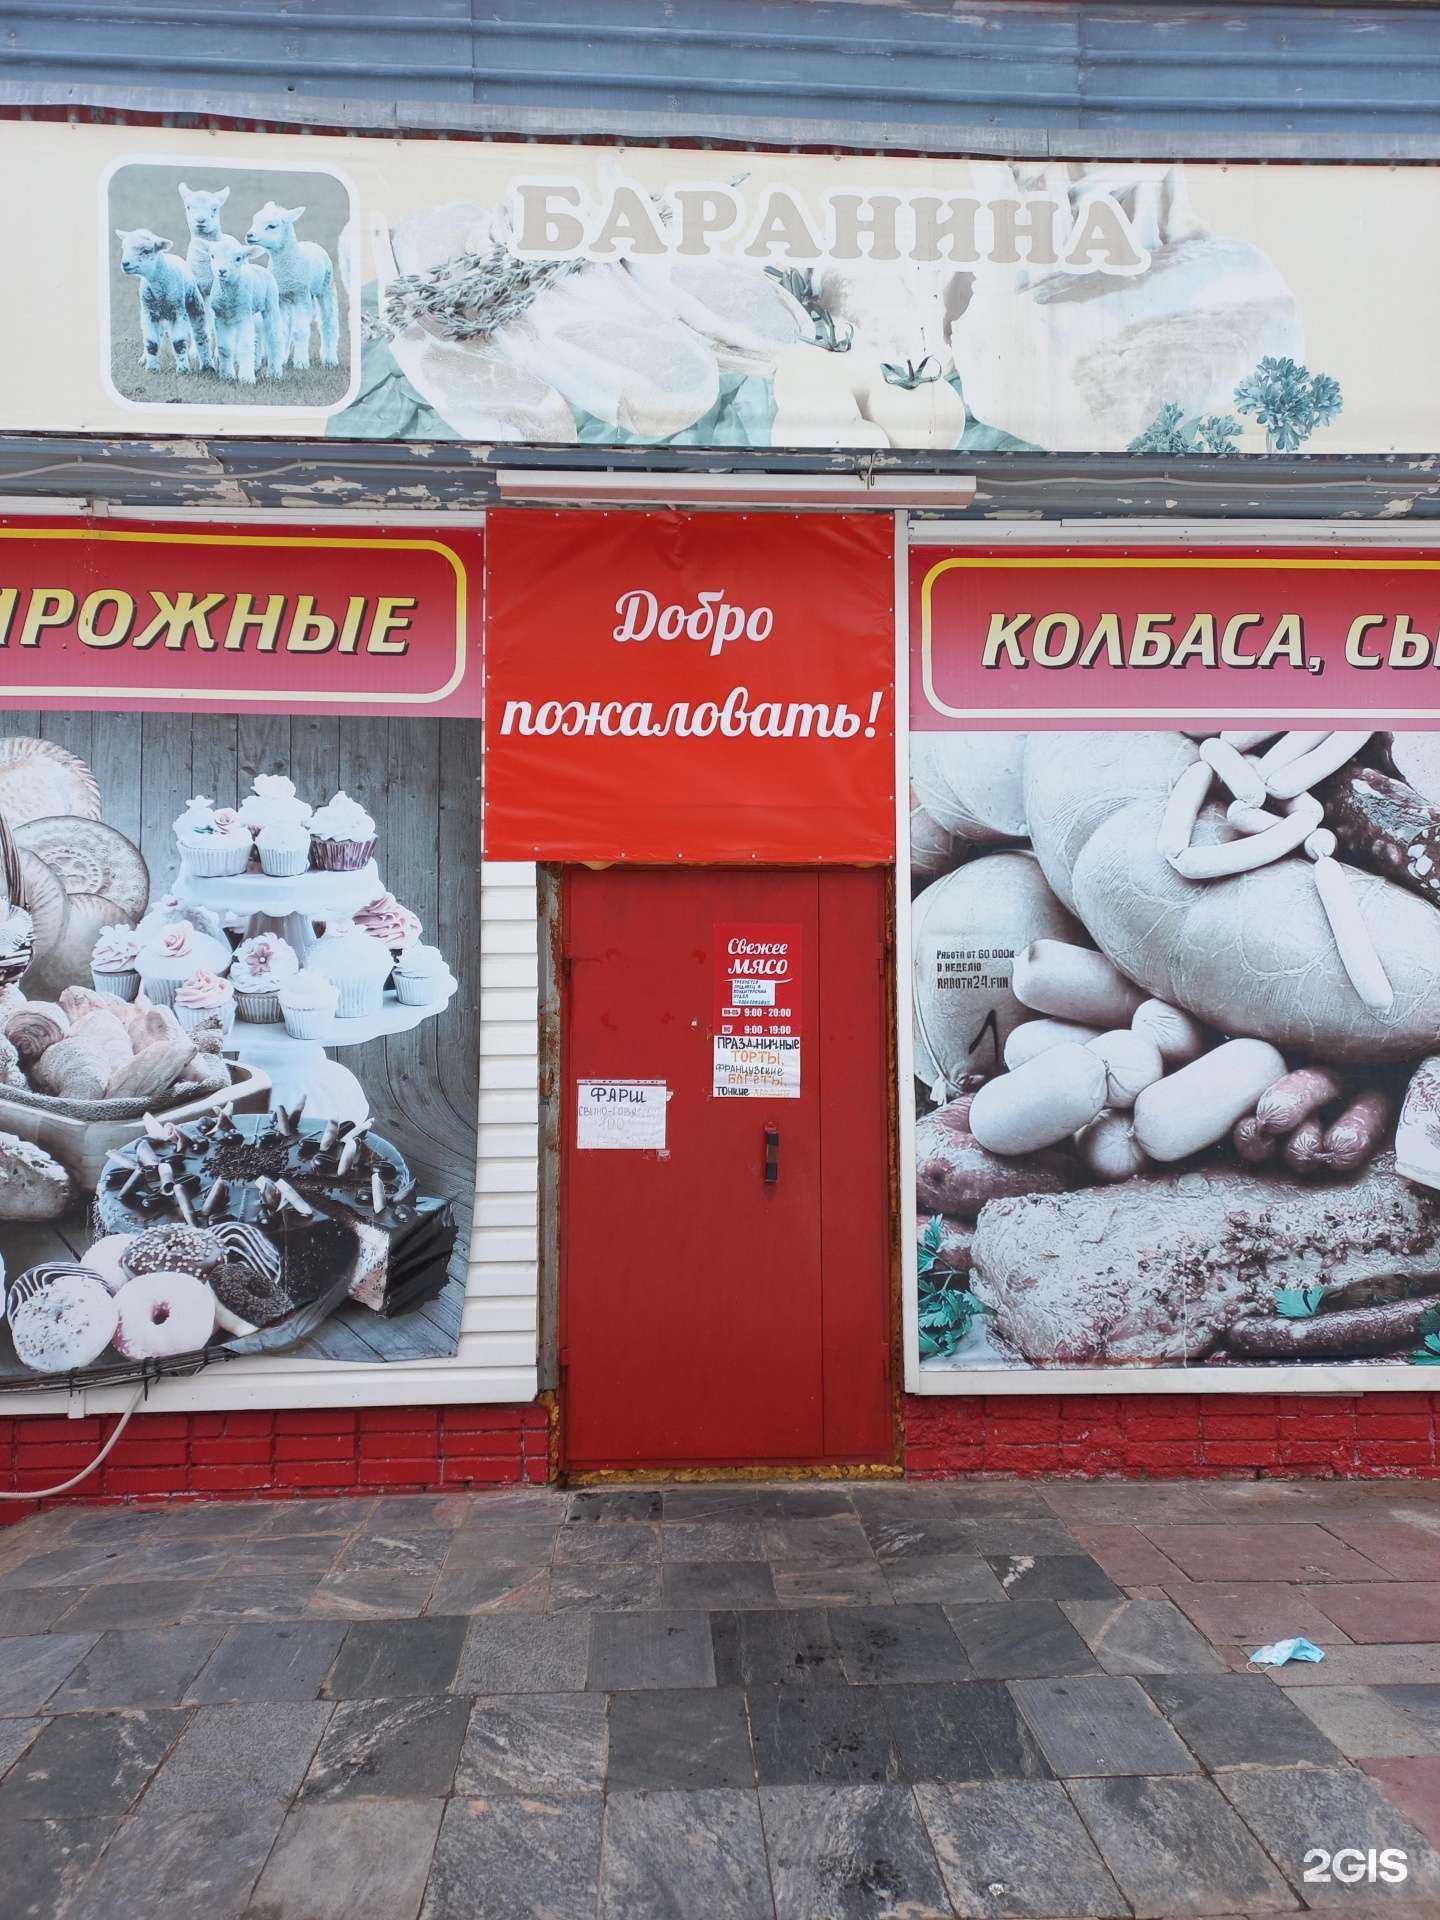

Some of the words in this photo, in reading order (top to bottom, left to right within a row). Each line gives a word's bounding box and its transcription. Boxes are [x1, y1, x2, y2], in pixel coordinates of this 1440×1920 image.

[516, 184, 1142, 266] БАРАНИНА
[612, 589, 774, 657] Добро
[980, 612, 1324, 675] КОЛБАСА,
[500, 686, 884, 738] пожаловать!
[727, 937, 788, 955] Свежее
[978, 949, 990, 958] 60
[937, 963, 943, 972] В
[945, 962, 982, 972] НЕДЕЛЮ
[744, 1008, 762, 1017] 9:00
[768, 1008, 791, 1017] 20:00
[744, 1025, 762, 1034] 9:00
[769, 1025, 791, 1034] 19:00
[591, 1087, 647, 1103] ФАРШ
